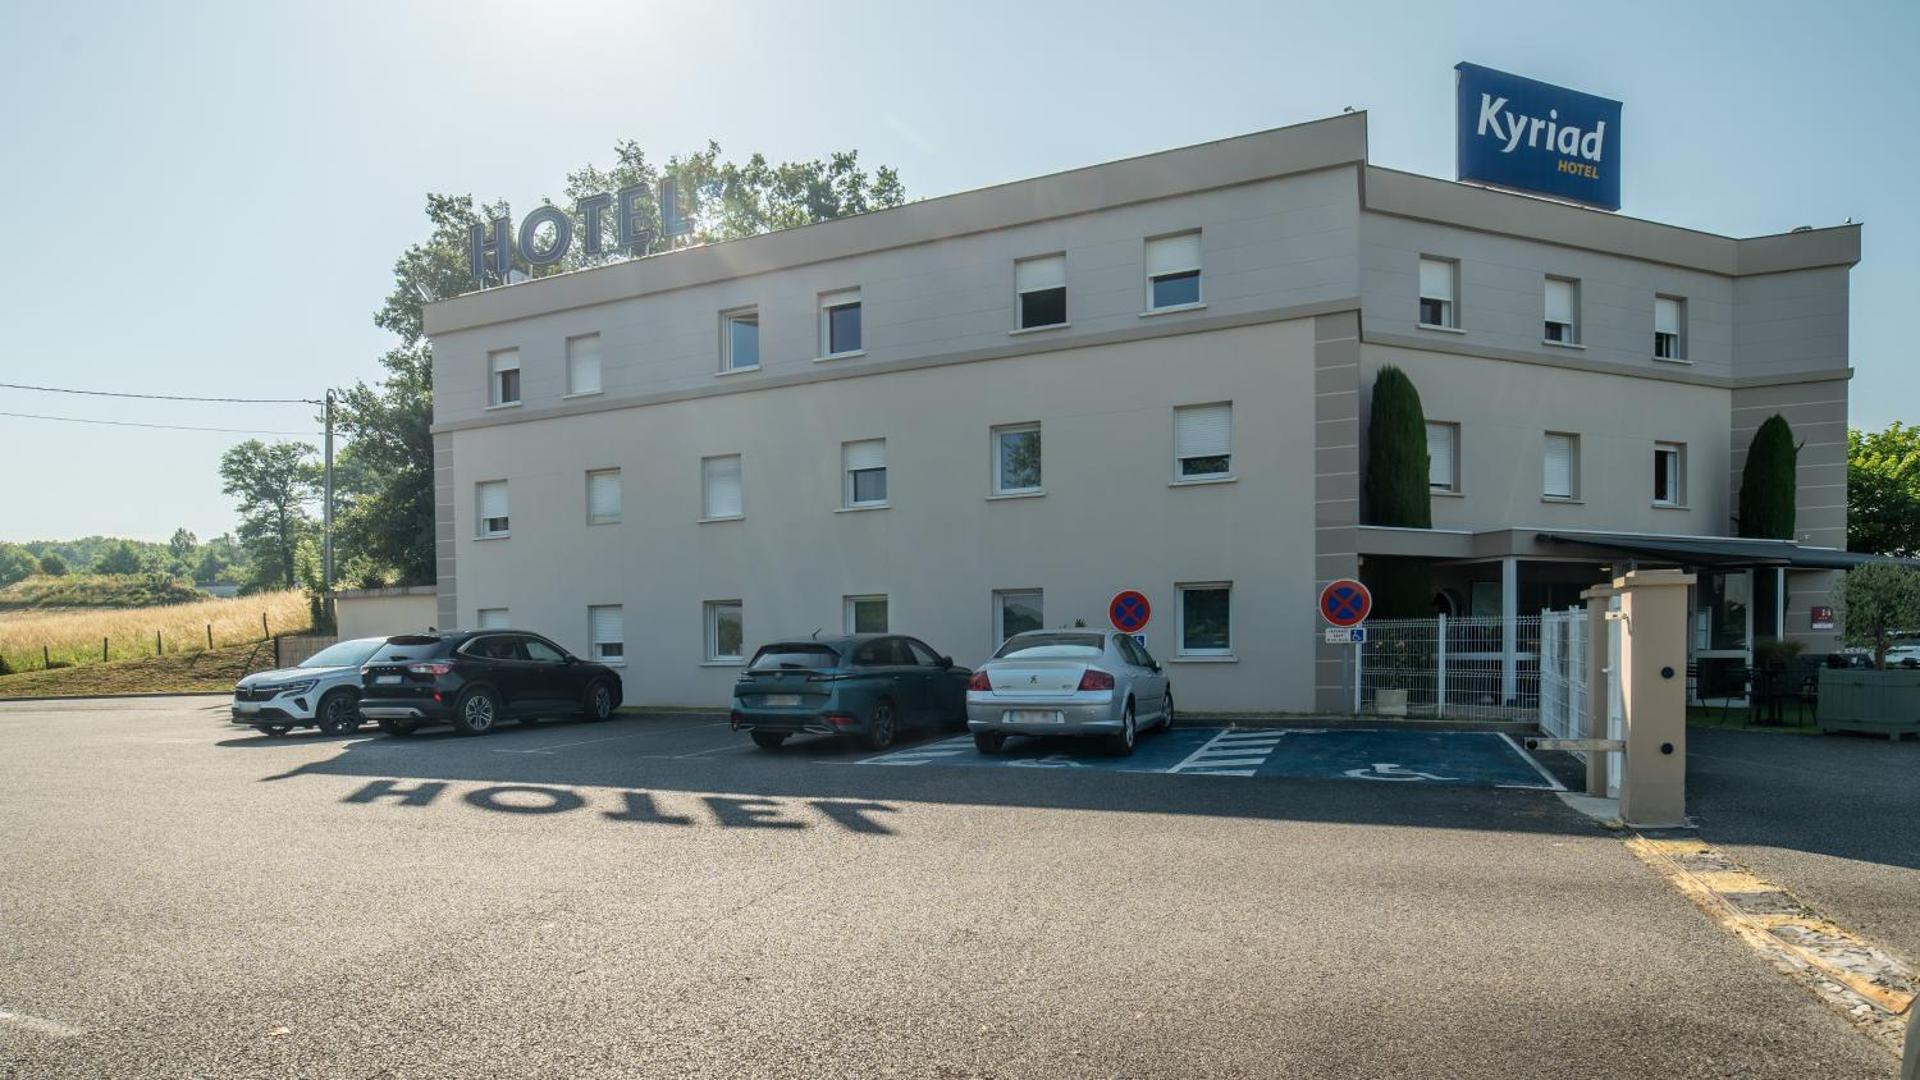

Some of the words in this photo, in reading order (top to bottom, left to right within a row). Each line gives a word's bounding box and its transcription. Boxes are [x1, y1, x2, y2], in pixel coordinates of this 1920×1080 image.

[1477, 93, 1605, 161] Kyriad
[1557, 160, 1599, 179] HOTEL
[470, 176, 694, 280] HOTEL
